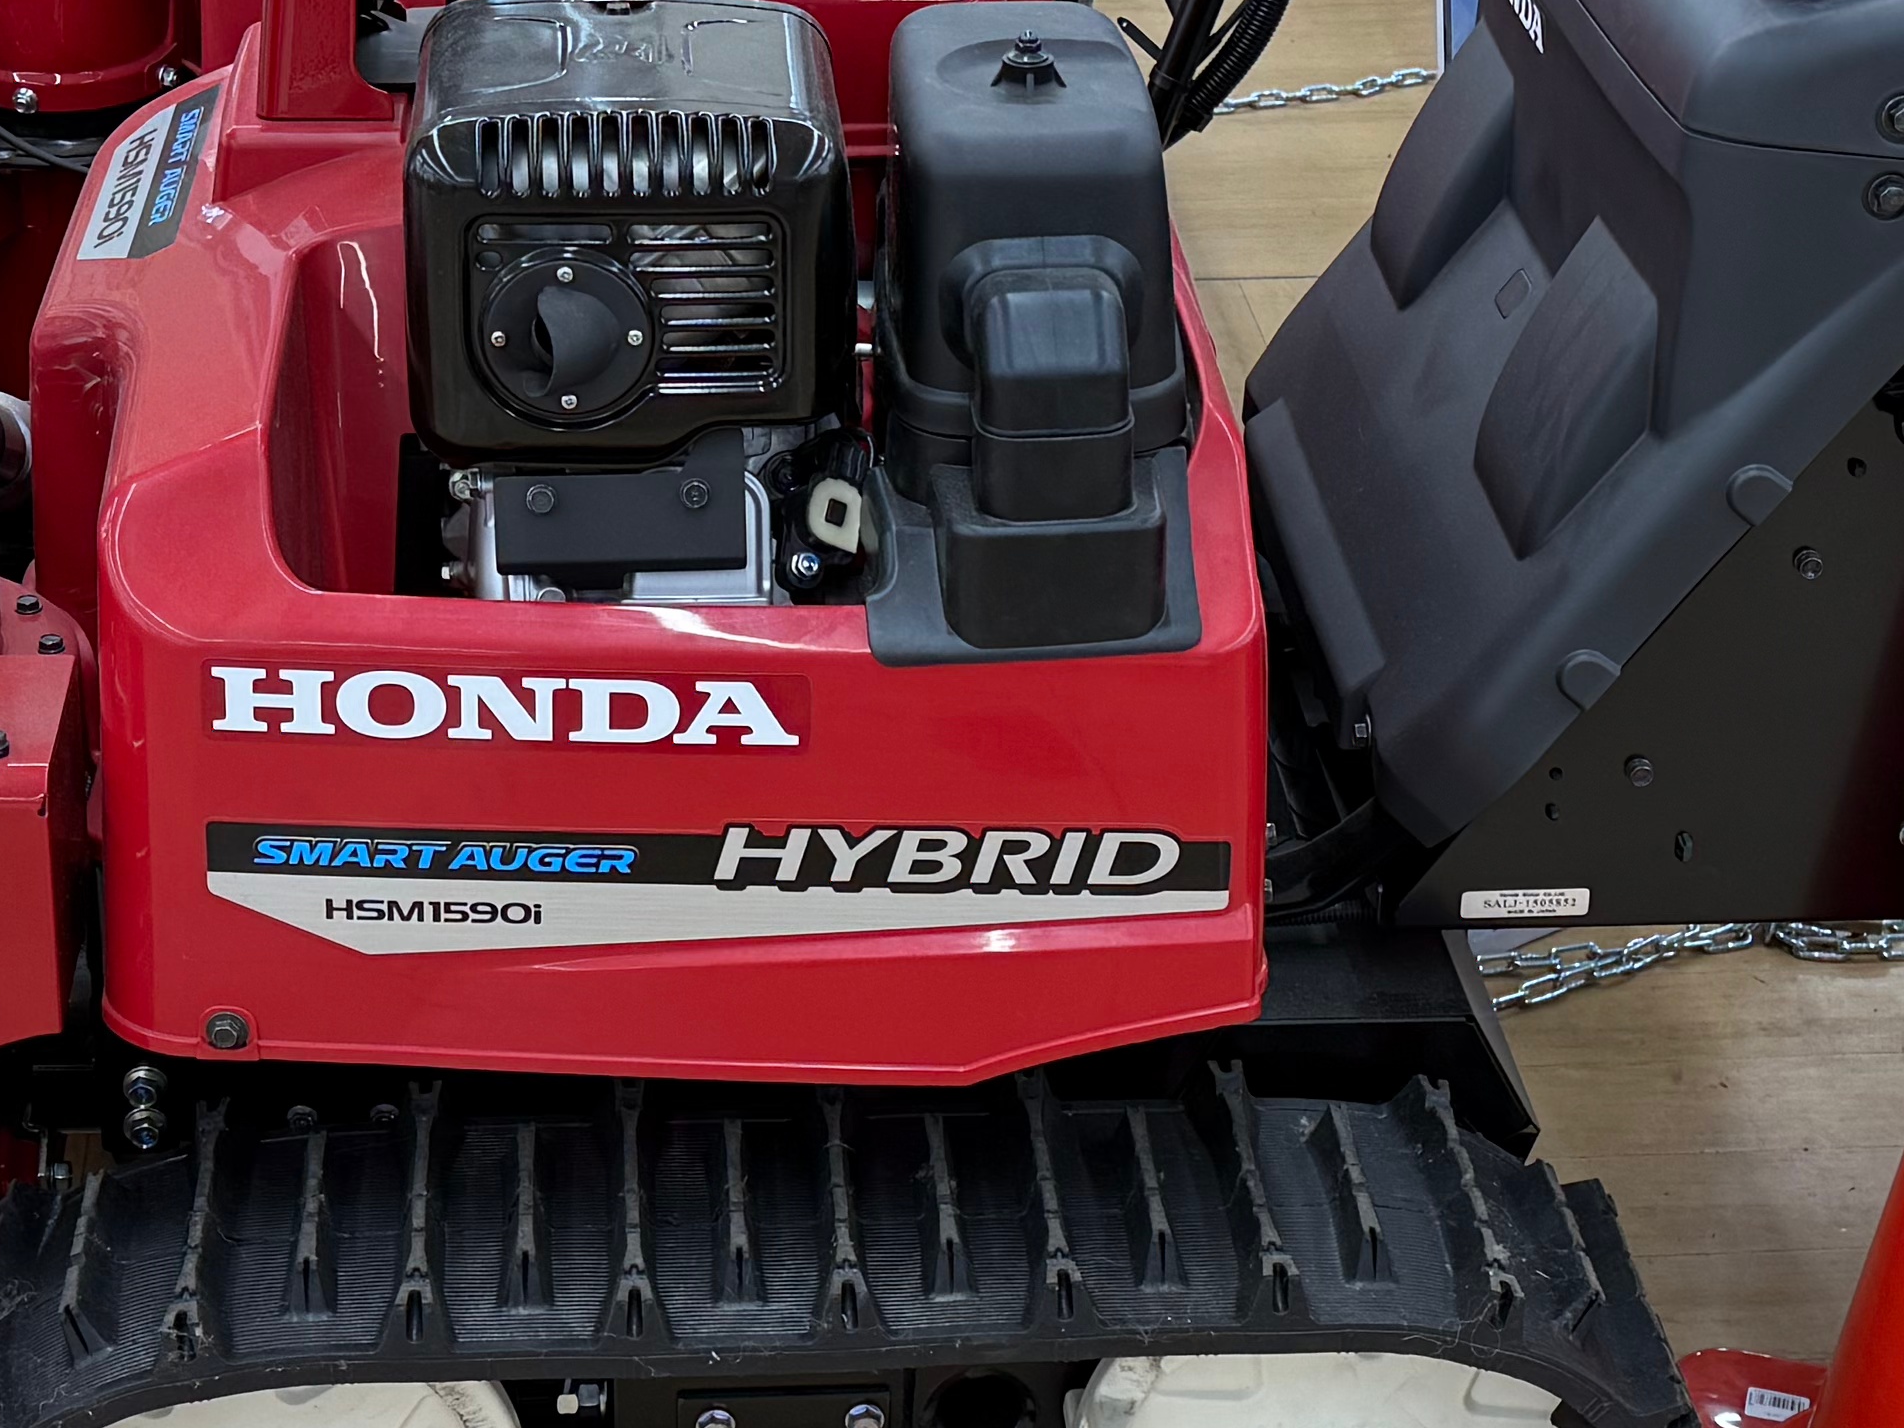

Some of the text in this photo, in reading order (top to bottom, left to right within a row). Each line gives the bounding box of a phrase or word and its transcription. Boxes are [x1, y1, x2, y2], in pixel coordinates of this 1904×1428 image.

[94, 128, 158, 249] HSM1590i
[149, 106, 204, 226] SMART AUGER
[210, 666, 801, 746] HONDA
[252, 837, 637, 876] SMART AUGER
[712, 827, 1181, 889] HYBRID
[325, 896, 543, 924] HSM1590i
